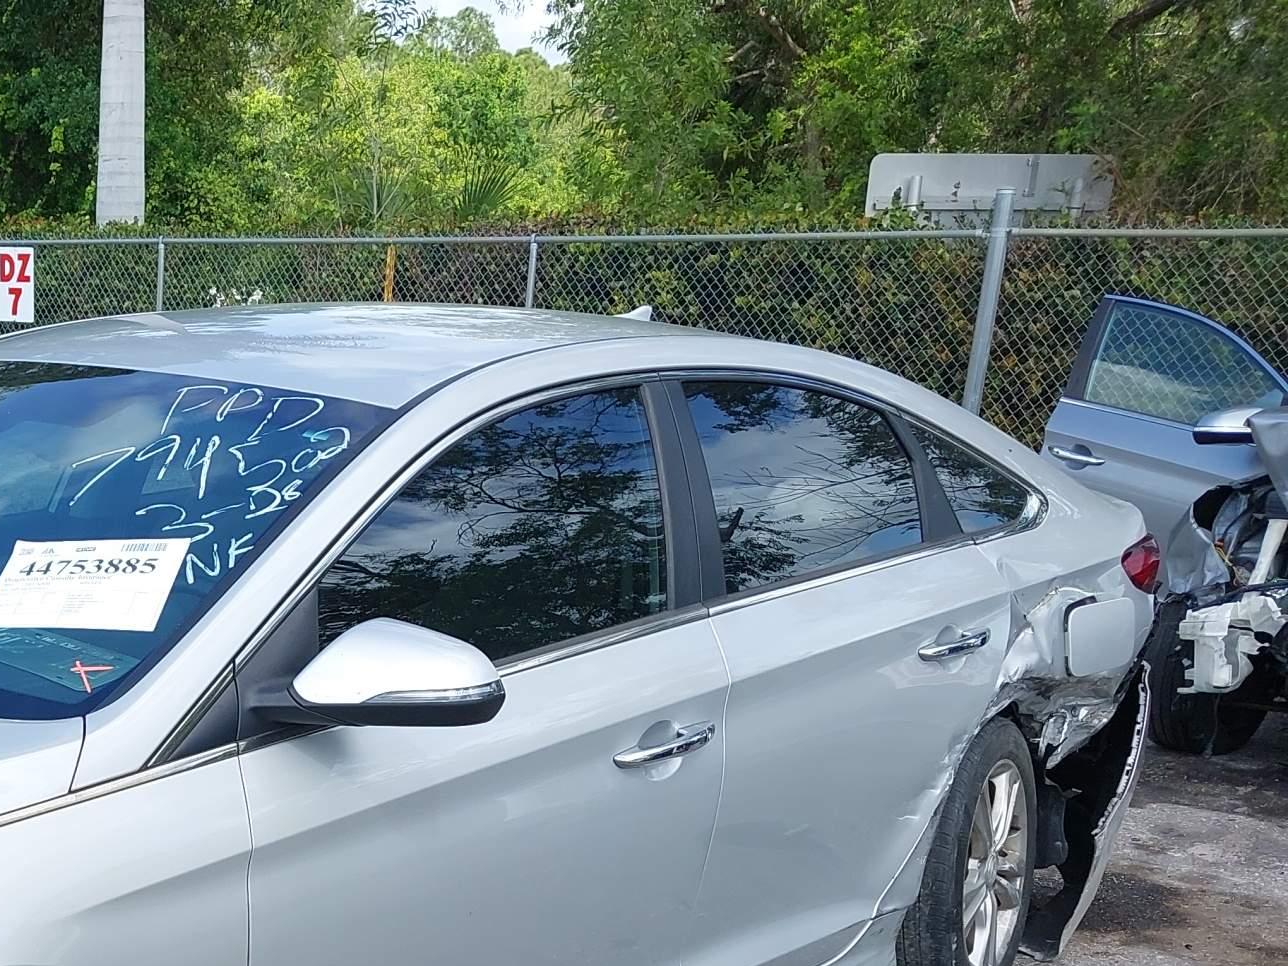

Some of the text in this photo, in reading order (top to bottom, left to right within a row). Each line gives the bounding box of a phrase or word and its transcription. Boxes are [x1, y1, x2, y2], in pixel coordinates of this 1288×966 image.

[0, 253, 31, 283] DZ
[8, 287, 23, 316] 7
[19, 557, 159, 577] 44753885
